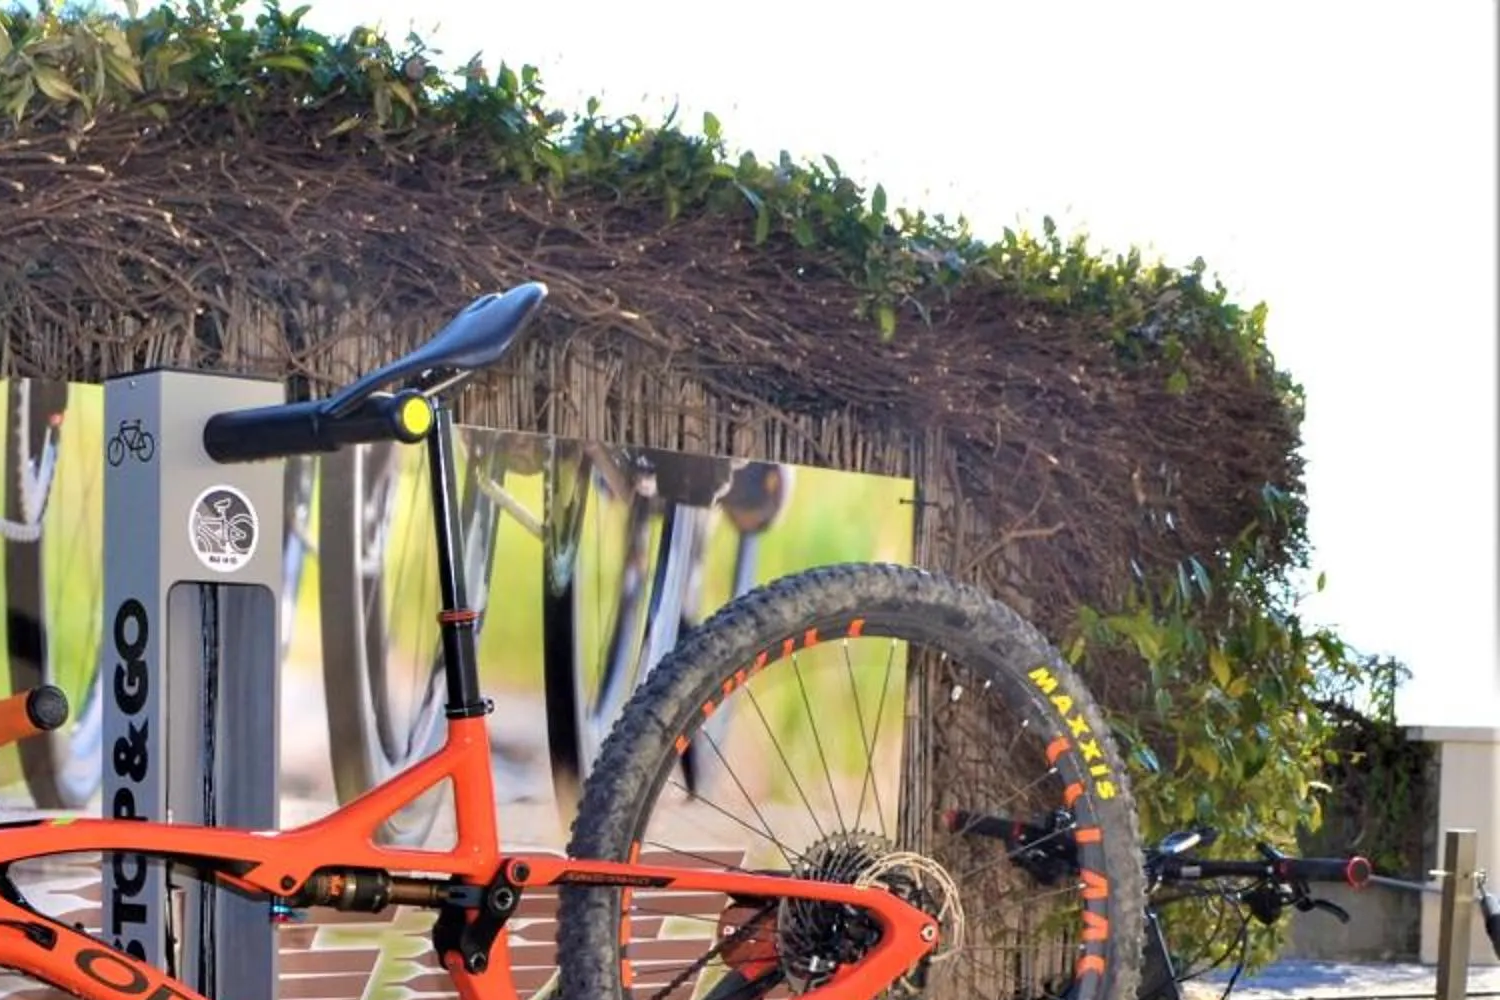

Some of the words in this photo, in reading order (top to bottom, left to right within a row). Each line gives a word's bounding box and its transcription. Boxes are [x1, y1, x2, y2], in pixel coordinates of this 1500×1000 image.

[113, 598, 149, 715] GO
[113, 717, 149, 783] &
[1028, 666, 1116, 800] MAXXIS
